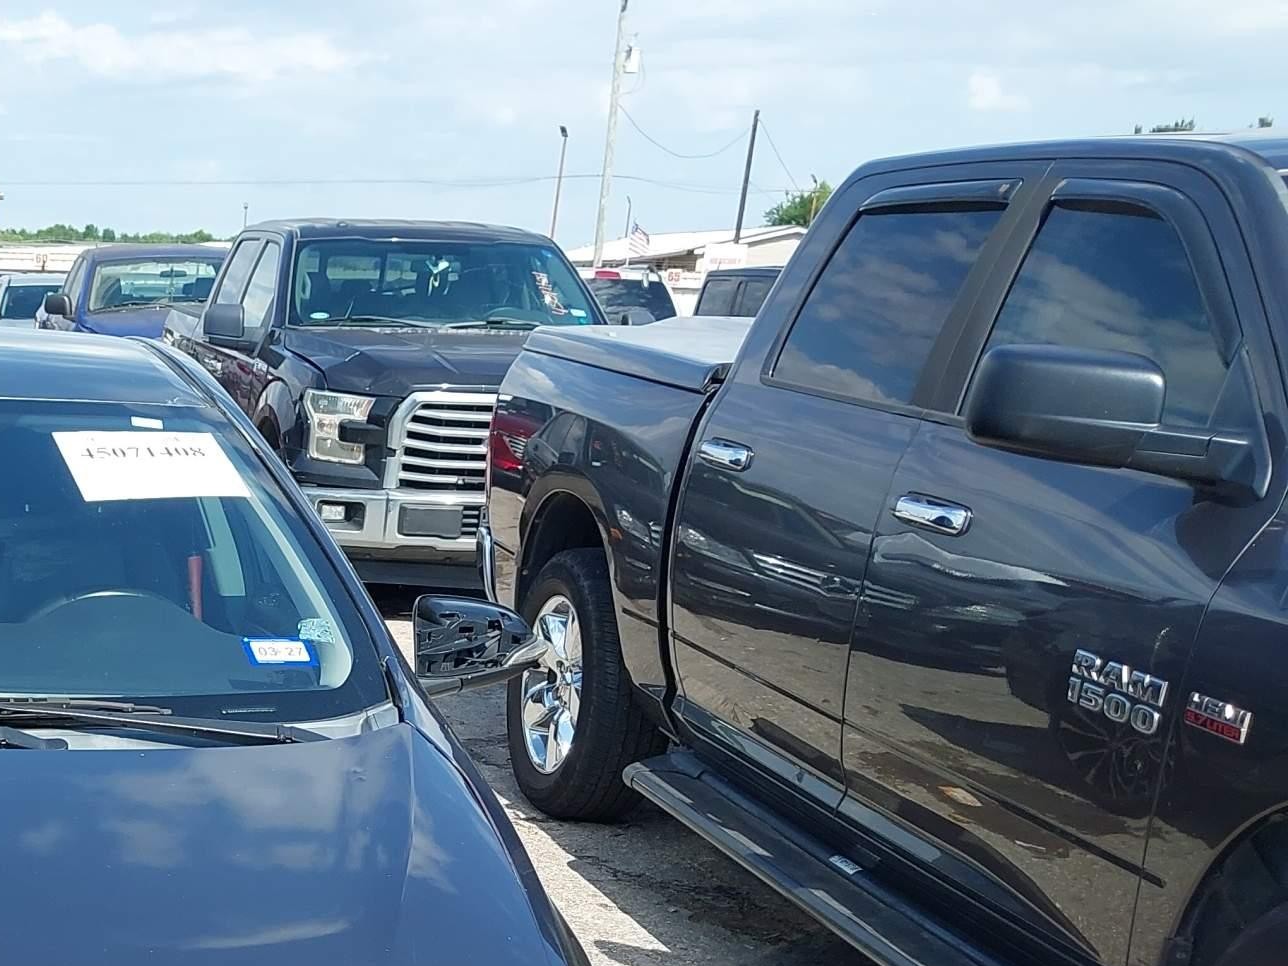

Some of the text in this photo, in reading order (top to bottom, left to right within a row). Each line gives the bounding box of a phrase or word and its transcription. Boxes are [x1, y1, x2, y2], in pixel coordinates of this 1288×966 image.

[667, 271, 681, 282] 65
[81, 447, 206, 460] 45071408
[1071, 649, 1169, 708] RAM
[1067, 676, 1161, 735] 1500
[1206, 716, 1242, 741] LITER
